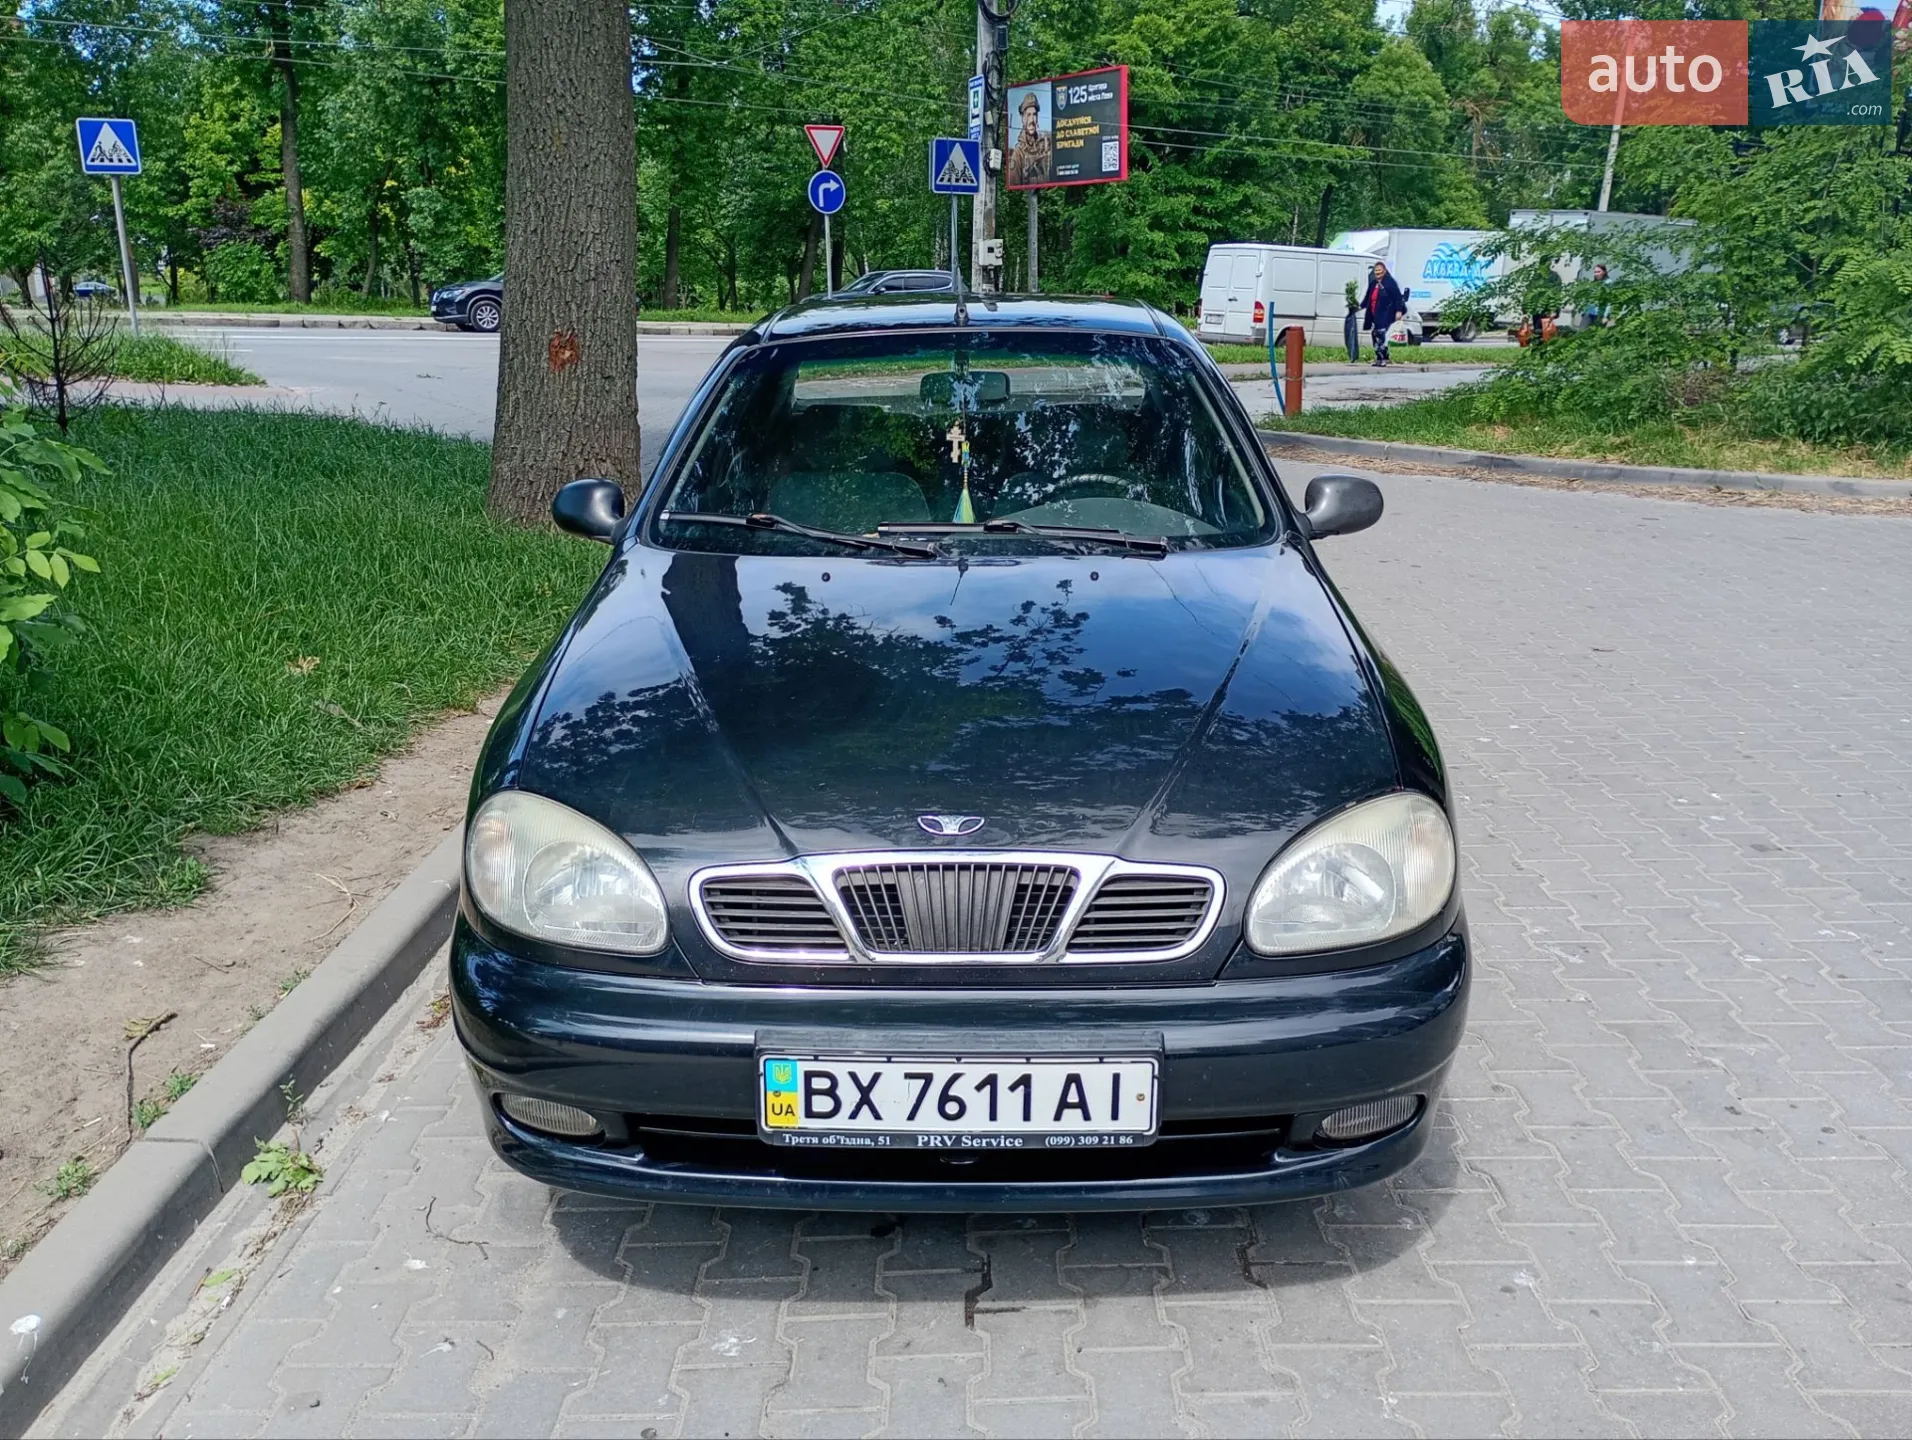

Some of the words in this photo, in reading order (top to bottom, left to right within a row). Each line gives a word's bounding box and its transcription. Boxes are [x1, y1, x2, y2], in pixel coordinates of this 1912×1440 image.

[1069, 85, 1088, 105] 125
[803, 1069, 884, 1121] BX
[903, 1071, 1032, 1122] 7611
[1053, 1072, 1121, 1122] AI
[771, 1103, 796, 1117] UA
[782, 1133, 819, 1146] Третя
[878, 1135, 891, 1146] 51
[917, 1134, 956, 1147] PRV
[961, 1134, 1023, 1147] Service
[1045, 1135, 1075, 1148] (099)
[1078, 1135, 1099, 1146] 309
[1102, 1135, 1115, 1145] 21
[1119, 1135, 1133, 1145] 86
